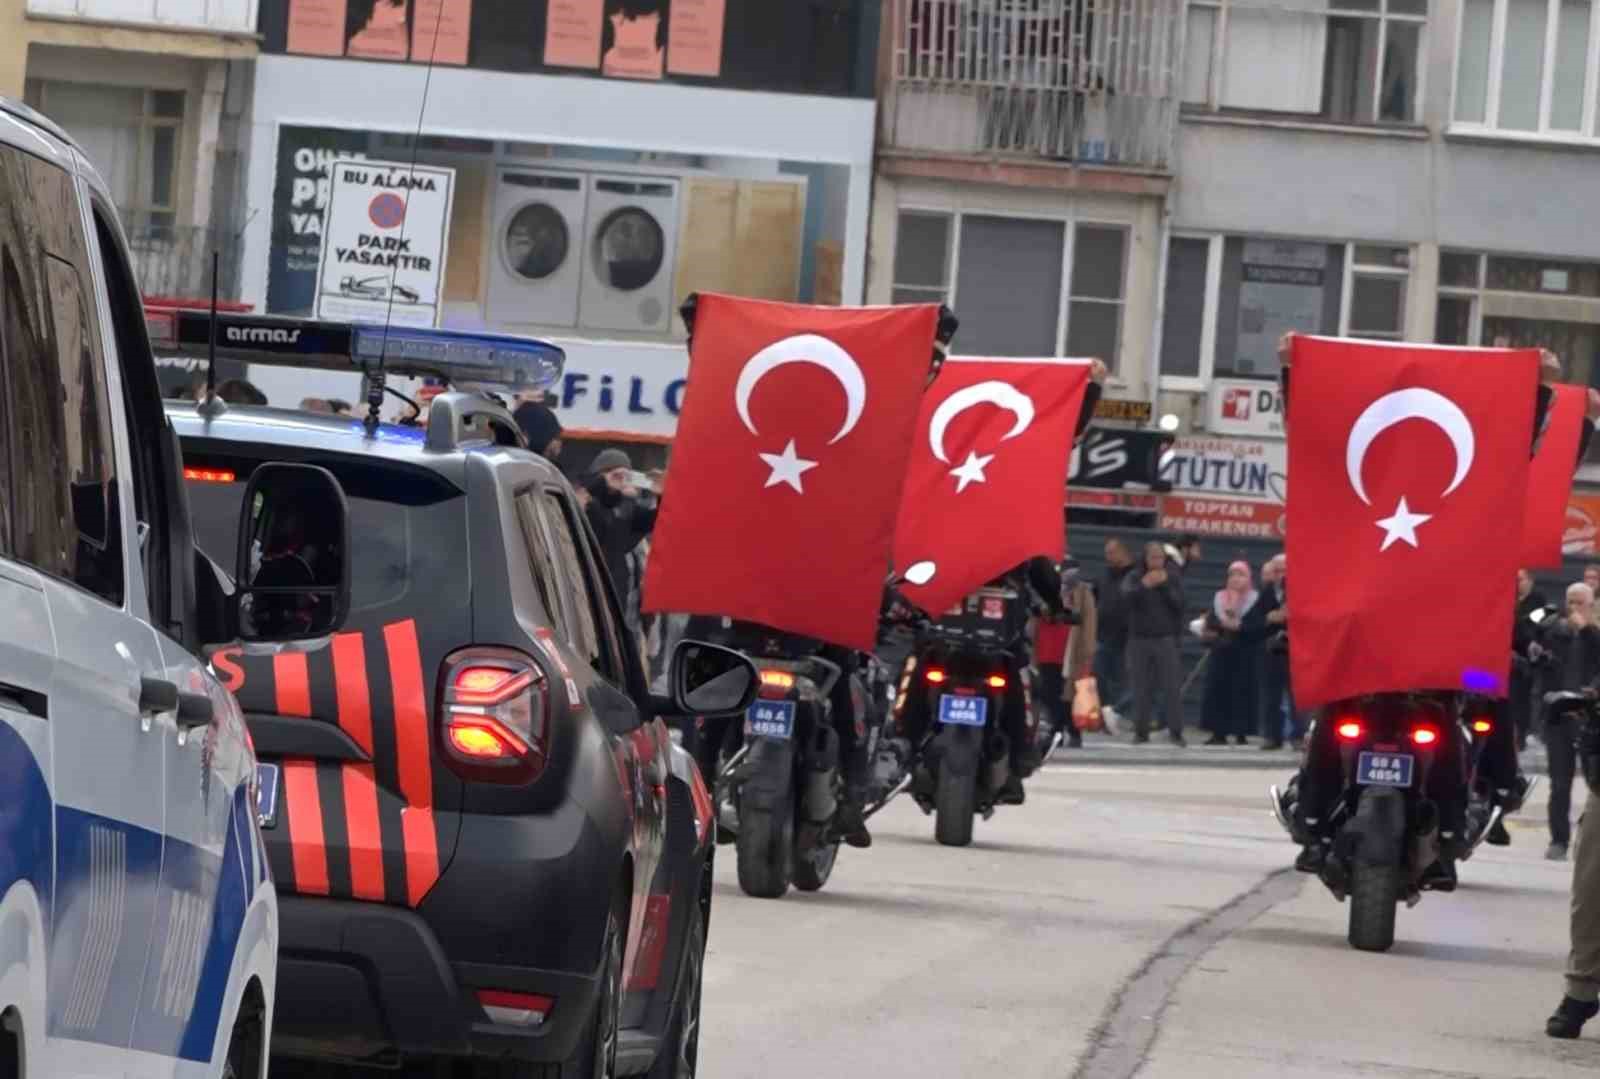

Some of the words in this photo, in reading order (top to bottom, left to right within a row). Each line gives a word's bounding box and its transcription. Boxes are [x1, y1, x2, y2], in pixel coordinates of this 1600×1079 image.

[343, 170, 368, 184] BU
[372, 174, 436, 192] ALANA
[358, 234, 411, 252] PARK
[336, 248, 431, 271] YASAKTIR
[227, 327, 301, 343] armas
[1185, 501, 1254, 518] TOPTAN
[1162, 517, 1271, 536] PERAKENDE
